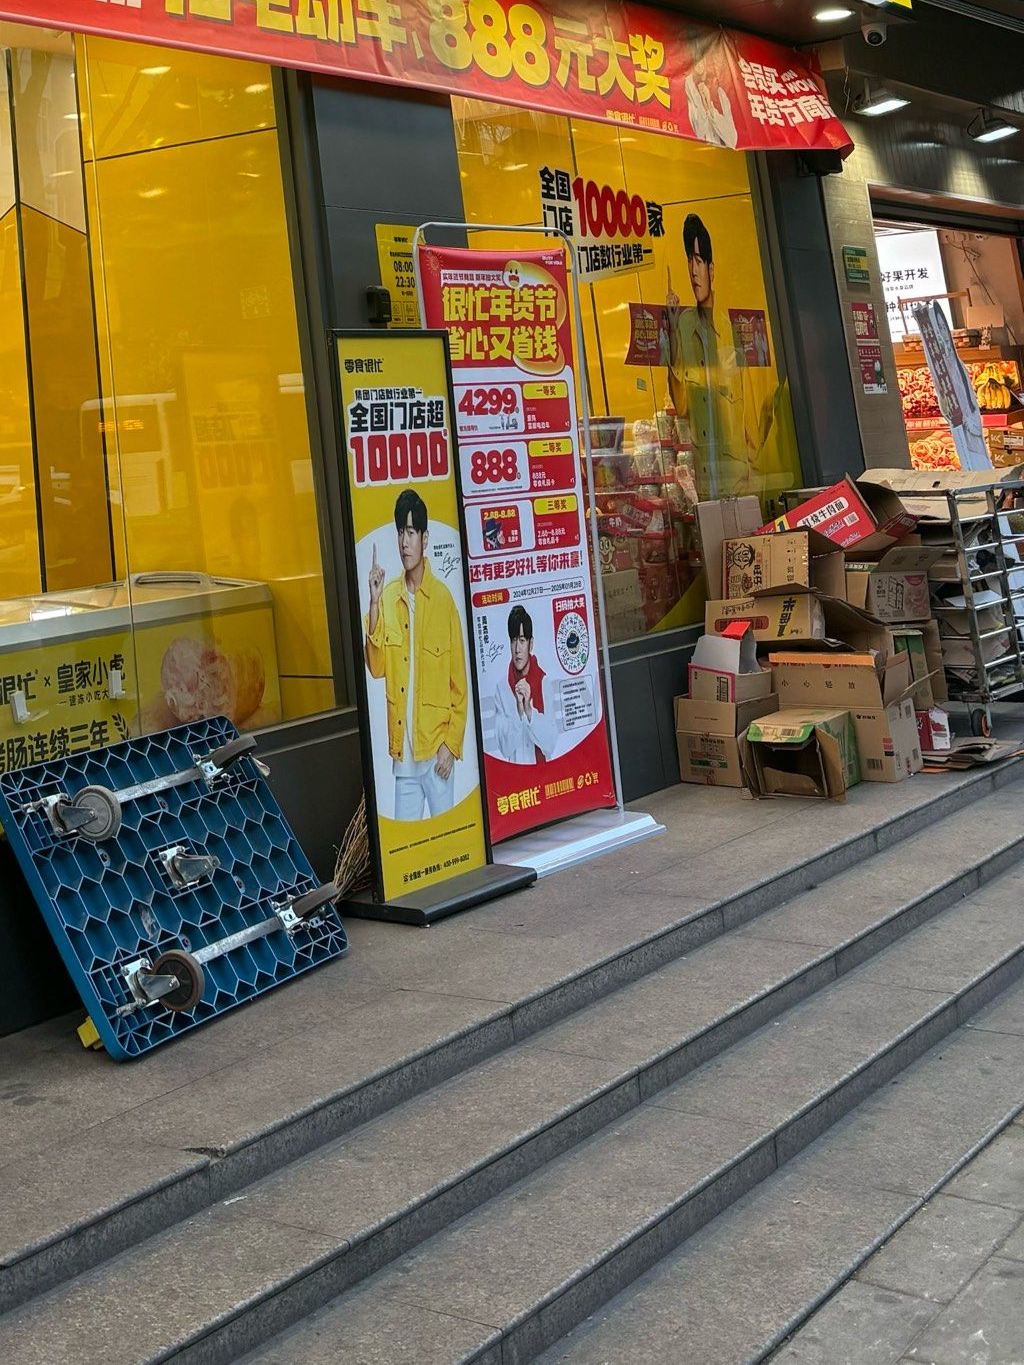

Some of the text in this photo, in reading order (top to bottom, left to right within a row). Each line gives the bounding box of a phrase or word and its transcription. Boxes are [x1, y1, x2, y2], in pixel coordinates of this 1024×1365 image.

[539, 166, 572, 202] 全国
[543, 203, 574, 238] 门店
[572, 176, 647, 238] 10000
[646, 201, 665, 238] 家
[393, 260, 414, 273] 08:00
[577, 244, 653, 275] 门店数行业第一
[395, 276, 416, 289] 22:30
[442, 286, 557, 322] 很忙年货节
[448, 325, 558, 361] 省心又省钱
[344, 358, 384, 374] 零食很忙
[458, 387, 518, 417] 4299
[536, 385, 557, 396] 一等奖
[349, 400, 444, 433] 全国门店超
[350, 431, 449, 483] 10000
[541, 442, 562, 453] 二等奖
[470, 448, 519, 485] 888
[547, 499, 568, 511] 三等奖
[469, 557, 536, 584] 还有更多好礼
[497, 786, 541, 816] 零食很忙
